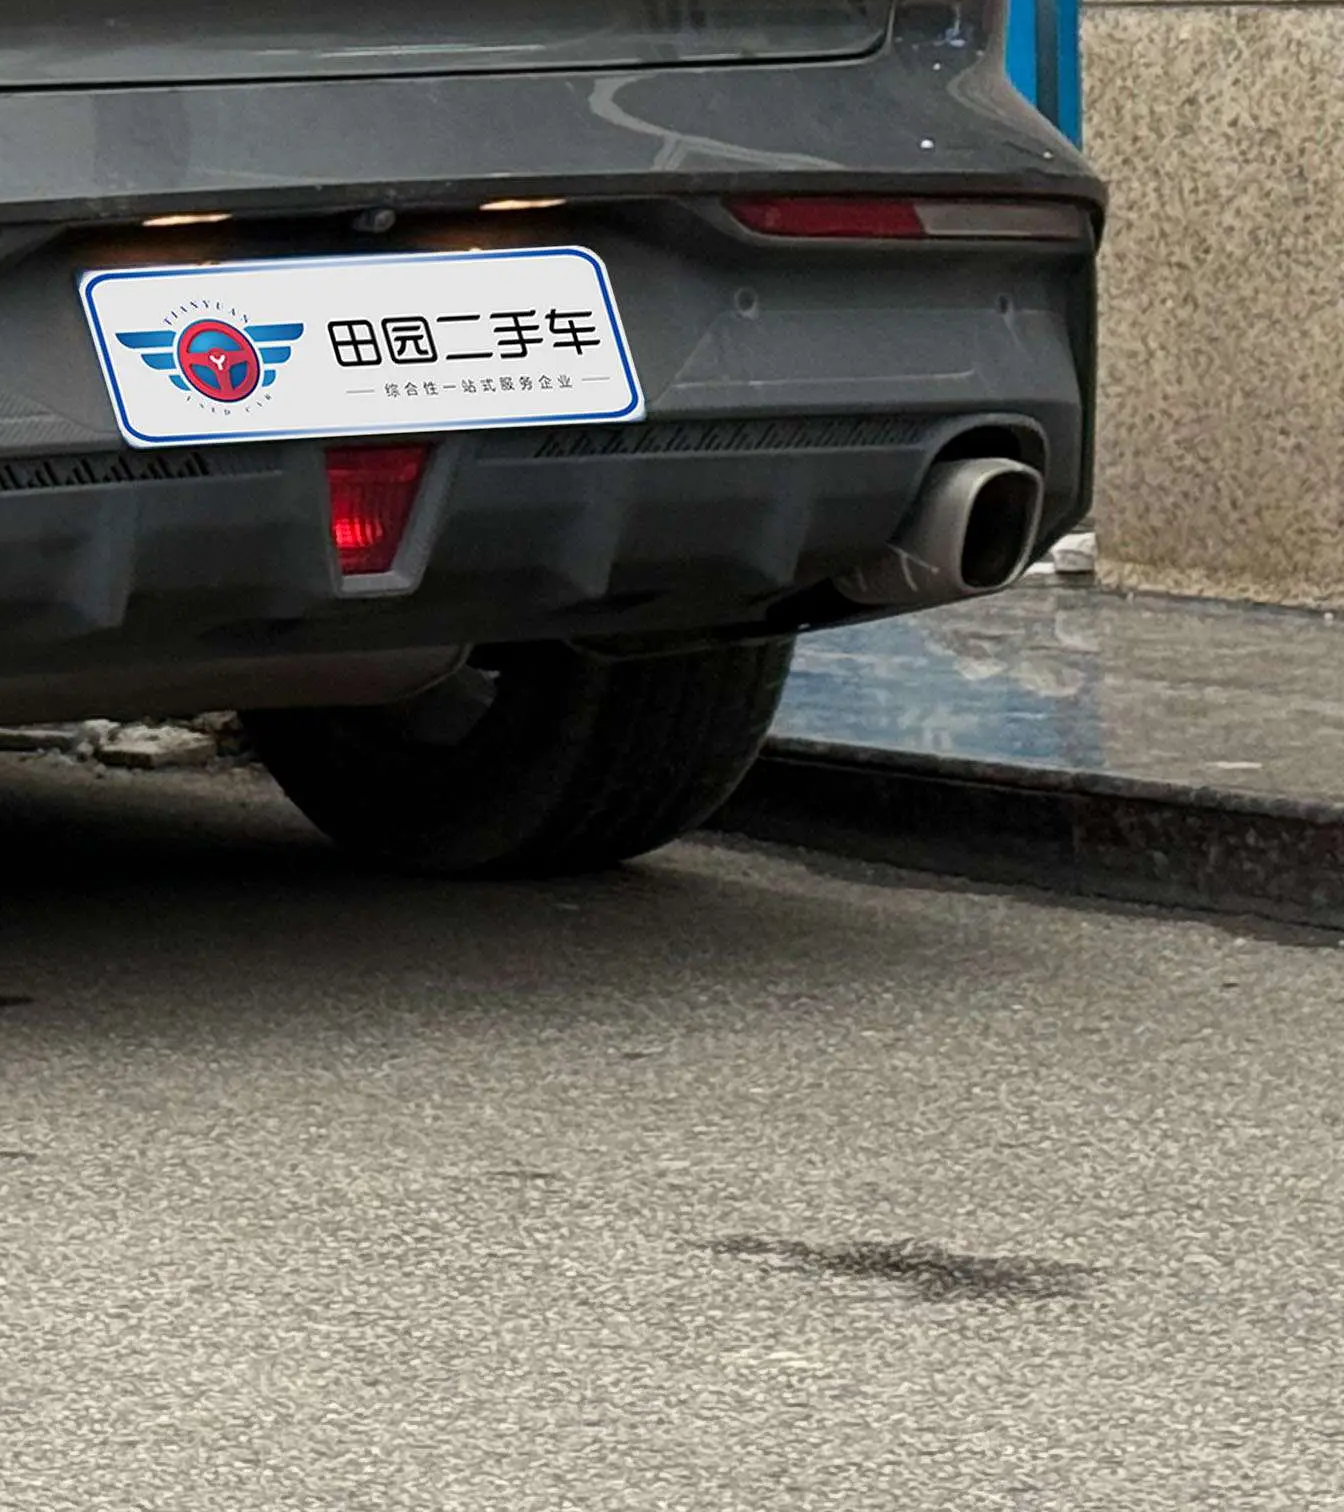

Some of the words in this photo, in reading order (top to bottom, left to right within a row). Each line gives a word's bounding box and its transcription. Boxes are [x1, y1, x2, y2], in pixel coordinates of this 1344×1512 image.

[327, 308, 602, 368] 田园二手车
[383, 374, 573, 399] 综合性一站式服务企业
